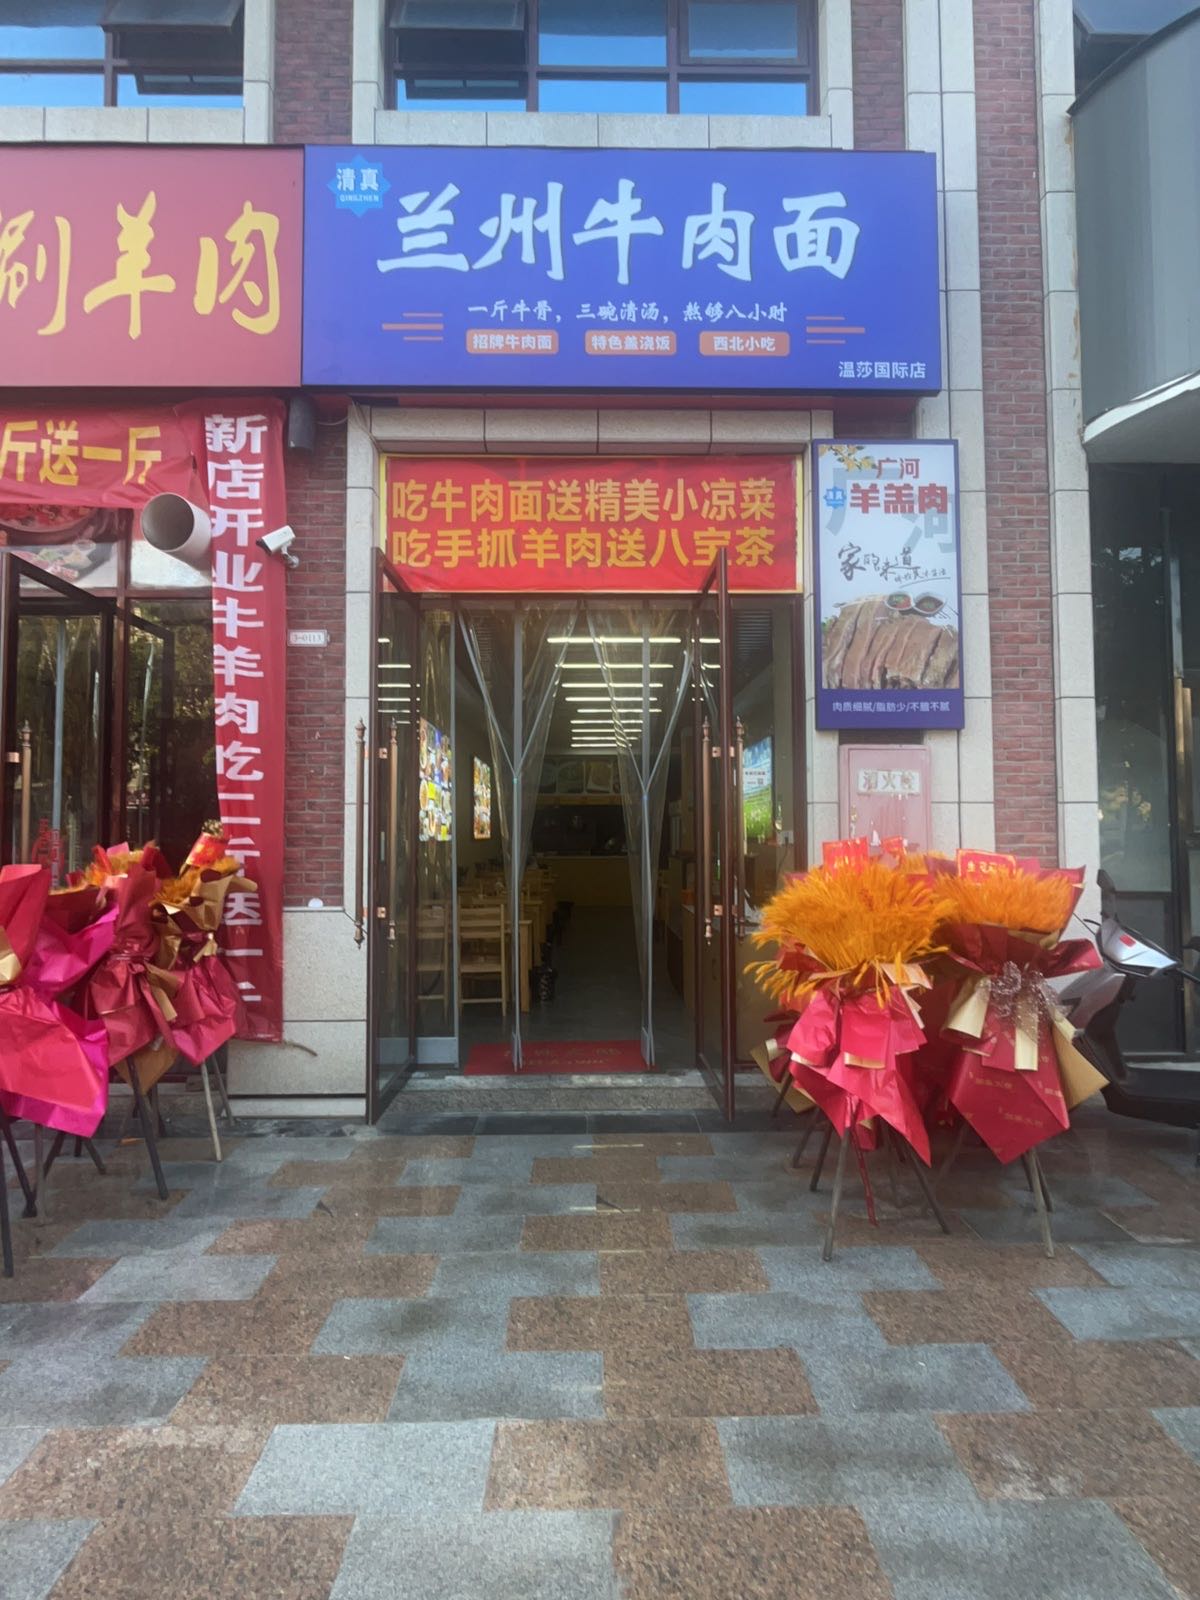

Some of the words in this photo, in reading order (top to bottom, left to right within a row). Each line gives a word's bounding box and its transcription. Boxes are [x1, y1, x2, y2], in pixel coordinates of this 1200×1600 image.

[336, 168, 379, 191] 清真
[377, 179, 861, 285] 兰州牛肉面
[472, 333, 553, 351] 招牌牛肉面
[591, 335, 671, 352] 特色盖浇饭
[712, 336, 777, 352] 西北小吃
[838, 361, 927, 379] 温莎国际店
[876, 457, 920, 479] 广河
[391, 478, 776, 523] 吃牛肉面送精美小凉菜
[850, 483, 949, 514] 羊羔肉
[391, 527, 775, 568] 吃手抓羊肉送八宝茶
[838, 541, 921, 581] 家的味道
[862, 770, 916, 791] 消火栓
